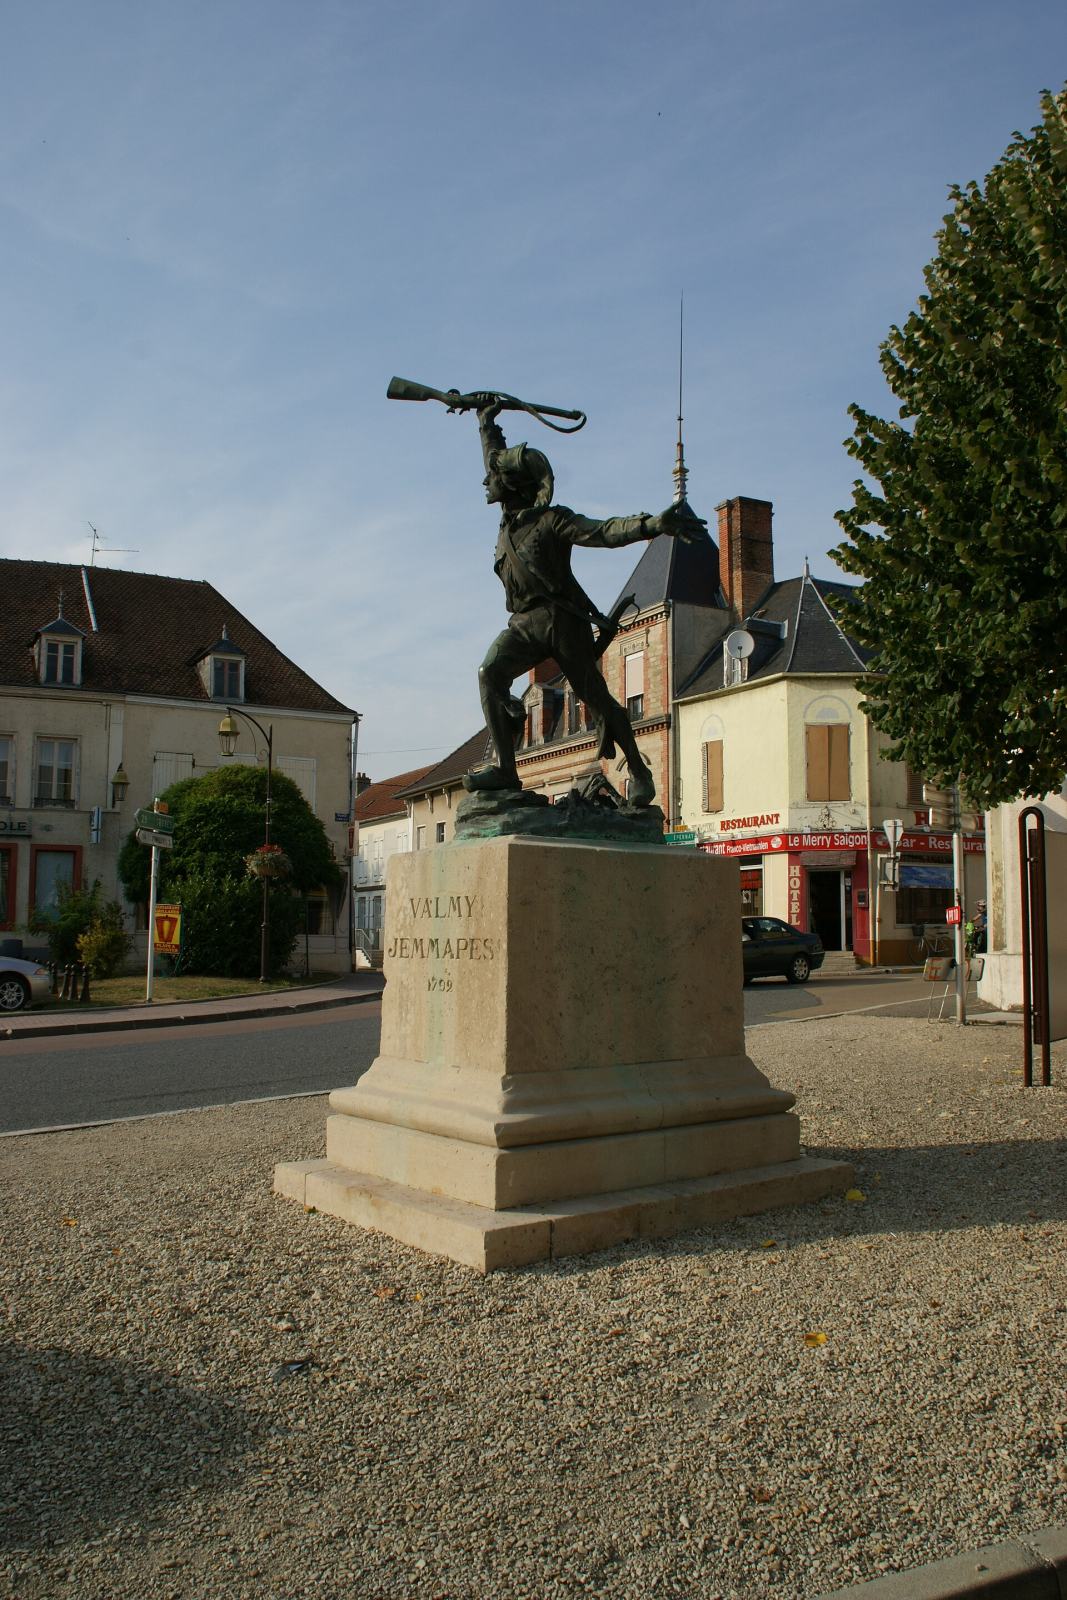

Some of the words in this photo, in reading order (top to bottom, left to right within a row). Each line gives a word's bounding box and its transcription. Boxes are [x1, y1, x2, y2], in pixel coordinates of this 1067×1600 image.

[720, 813, 780, 831] RESTAURANT
[788, 835, 799, 847] Le
[802, 834, 831, 848] Merry
[834, 833, 867, 848] Saigon
[410, 895, 478, 919] VALMY
[789, 865, 801, 926] HOTEL
[388, 937, 496, 961] JEMMAPES
